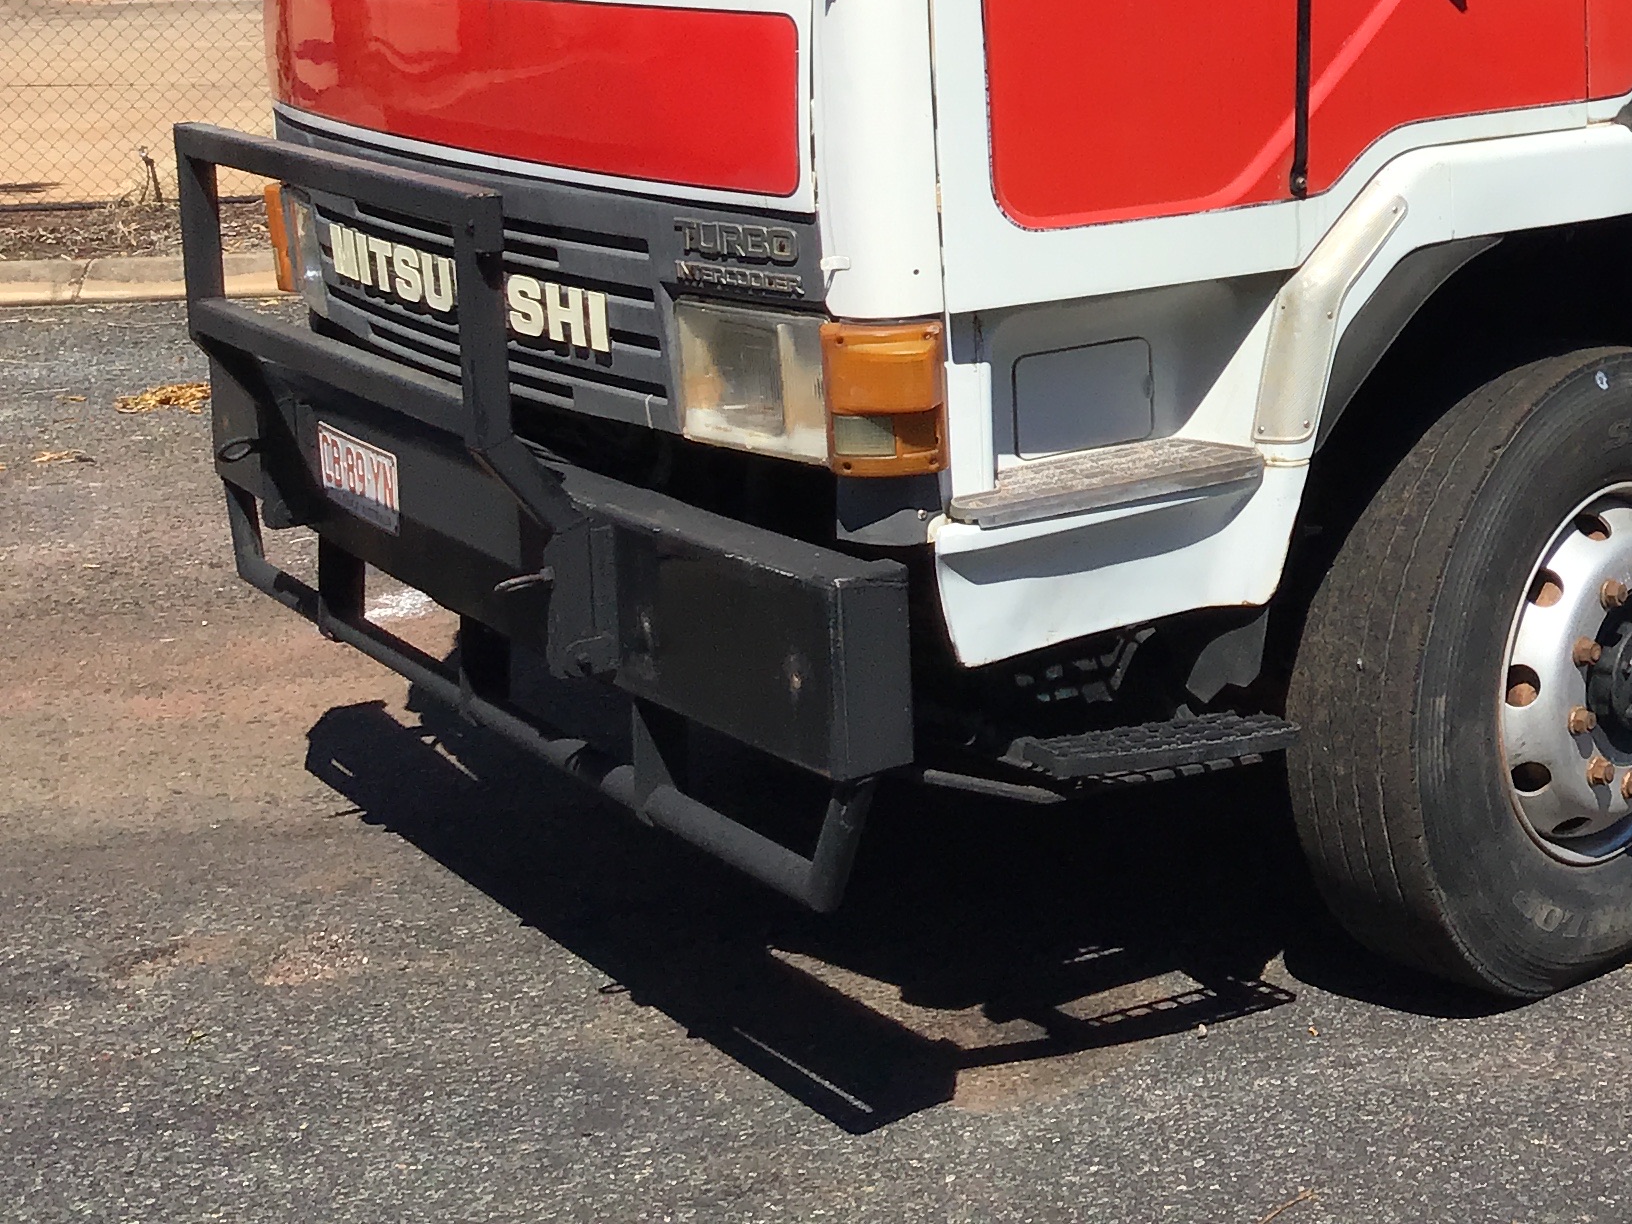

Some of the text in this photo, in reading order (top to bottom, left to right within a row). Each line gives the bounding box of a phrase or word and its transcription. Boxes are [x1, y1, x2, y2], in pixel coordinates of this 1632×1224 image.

[674, 217, 799, 265] TURBO
[329, 222, 611, 353] MITSUSHI
[674, 259, 805, 296] INTERCOOLER
